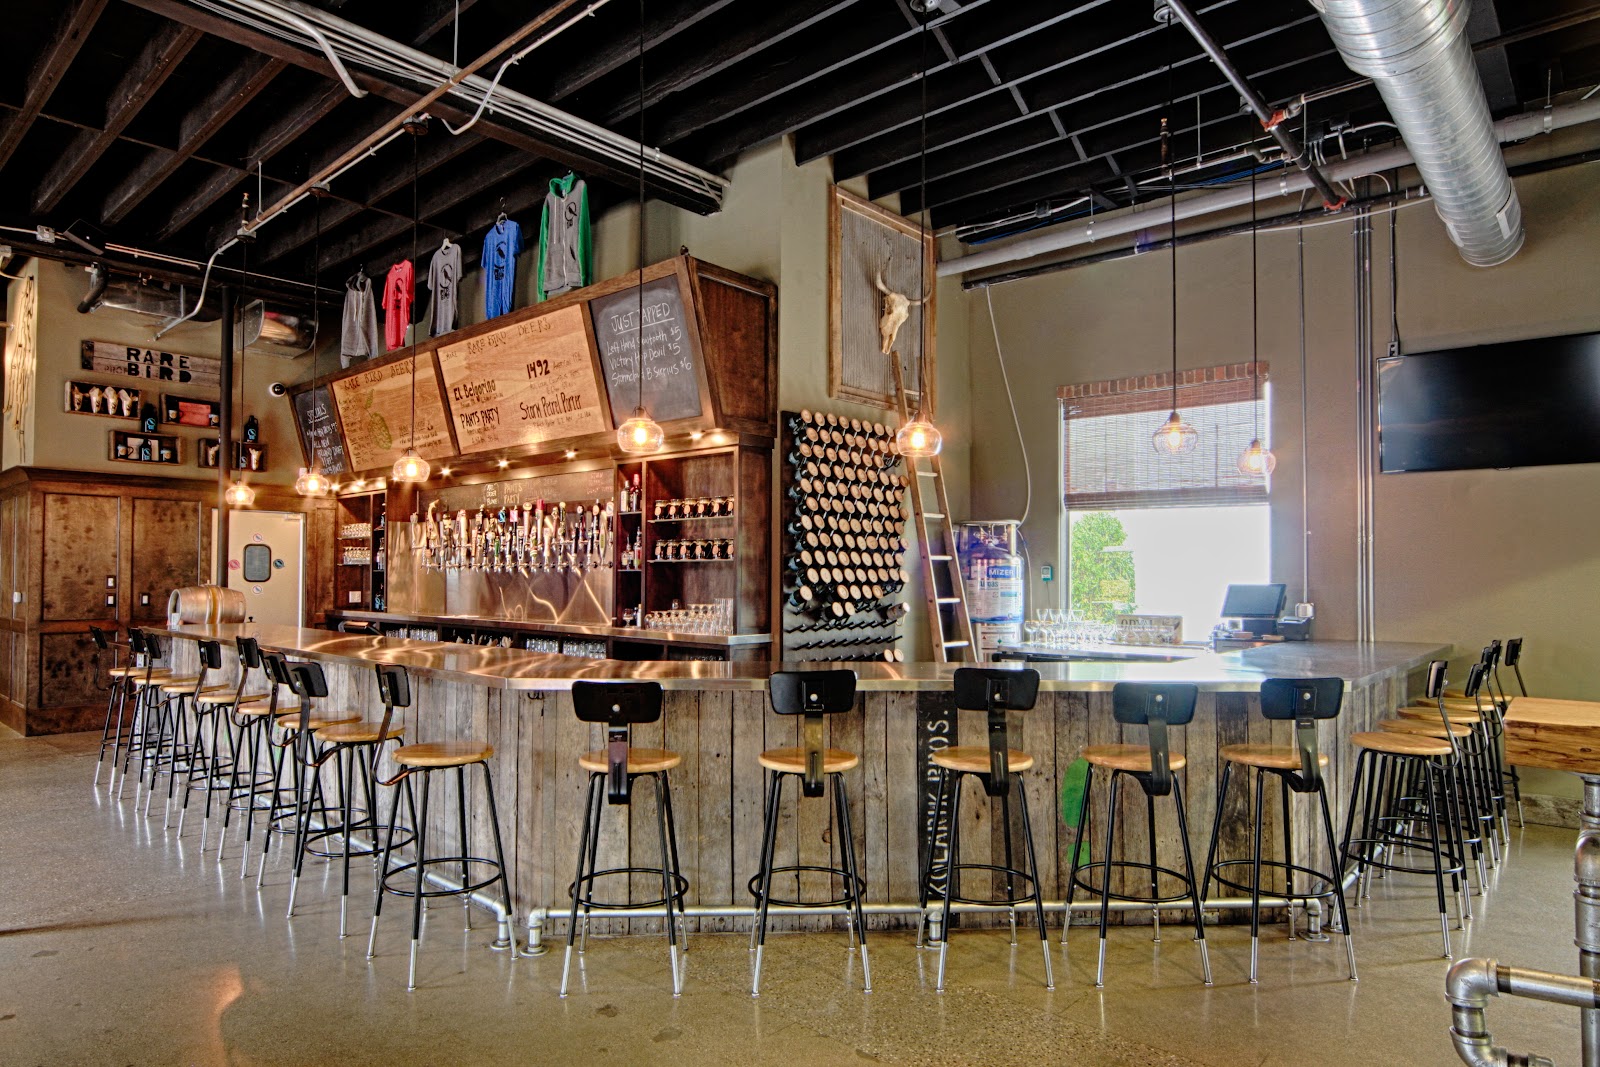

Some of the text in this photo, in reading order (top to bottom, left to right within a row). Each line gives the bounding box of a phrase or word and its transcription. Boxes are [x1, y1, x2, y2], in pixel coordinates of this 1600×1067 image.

[518, 317, 551, 336] BEERS
[611, 303, 670, 332] JUST APPED
[606, 341, 619, 356] Left
[670, 326, 682, 341] $5
[649, 345, 666, 361] Devil
[667, 342, 681, 356] $5
[127, 347, 189, 369] RARE
[527, 359, 550, 379] 1492
[680, 357, 692, 370] $6
[127, 362, 192, 383] BIRD
[560, 391, 582, 413] Porter
[460, 411, 480, 429] PANTS
[480, 406, 500, 427] PARTY
[927, 710, 950, 782] BOS.
